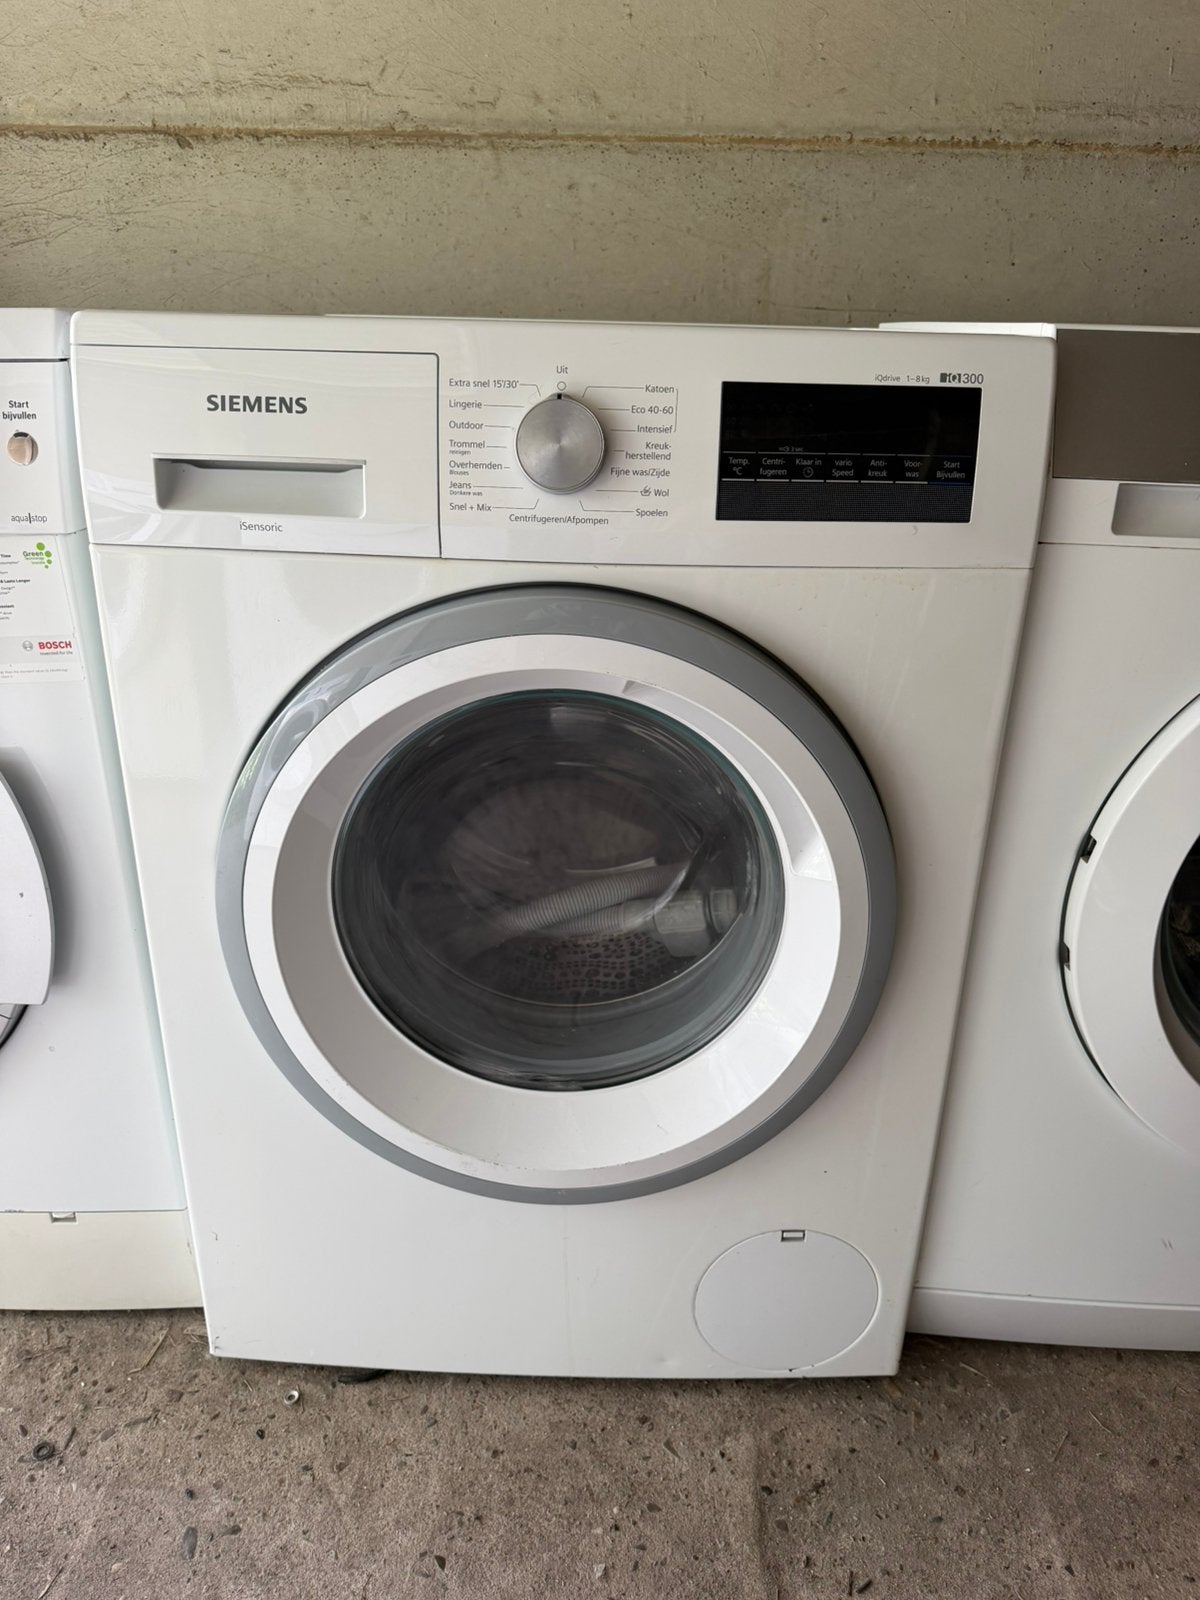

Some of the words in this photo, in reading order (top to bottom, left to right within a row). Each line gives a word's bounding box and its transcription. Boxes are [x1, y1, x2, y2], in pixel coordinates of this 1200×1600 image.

[556, 364, 568, 374] Uit
[448, 378, 470, 388] Extra
[472, 379, 490, 388] snel
[874, 373, 901, 382] iQdrive
[922, 375, 930, 384] kg
[645, 384, 674, 394] Katoen
[8, 400, 29, 408] Start
[206, 394, 308, 414] SIEMENS
[448, 400, 482, 410] Lingerie
[631, 404, 646, 414] Eco
[648, 406, 674, 414] 40-60
[2, 411, 37, 420] bijvullen
[448, 420, 484, 430] Outdoor
[637, 424, 673, 434] Intensief
[448, 439, 486, 449] Trommel
[645, 442, 672, 450] Kreuk-
[625, 451, 672, 460] herstellend
[448, 460, 502, 470] Overhemden
[728, 456, 750, 466] Temp.
[762, 457, 786, 466] Centri-
[796, 458, 814, 466] Klaar
[814, 458, 822, 466] in
[834, 458, 853, 466] vario
[870, 459, 888, 468] Anti-
[943, 460, 960, 469] Start
[610, 466, 630, 478] Fijne
[632, 468, 670, 478] was/Zijde
[732, 466, 742, 476] °C
[760, 467, 788, 477] fugeren
[832, 468, 854, 478] Speed
[936, 471, 966, 480] Bijvullen
[448, 480, 472, 490] Jeans
[654, 488, 670, 497] Wol
[449, 502, 468, 511] Snel
[476, 504, 492, 512] Mix
[635, 508, 669, 518] Spoelen
[508, 514, 609, 526] Centrifugeren/Afpompen
[239, 520, 284, 532] iSensoric
[38, 640, 72, 650] BOSCH
